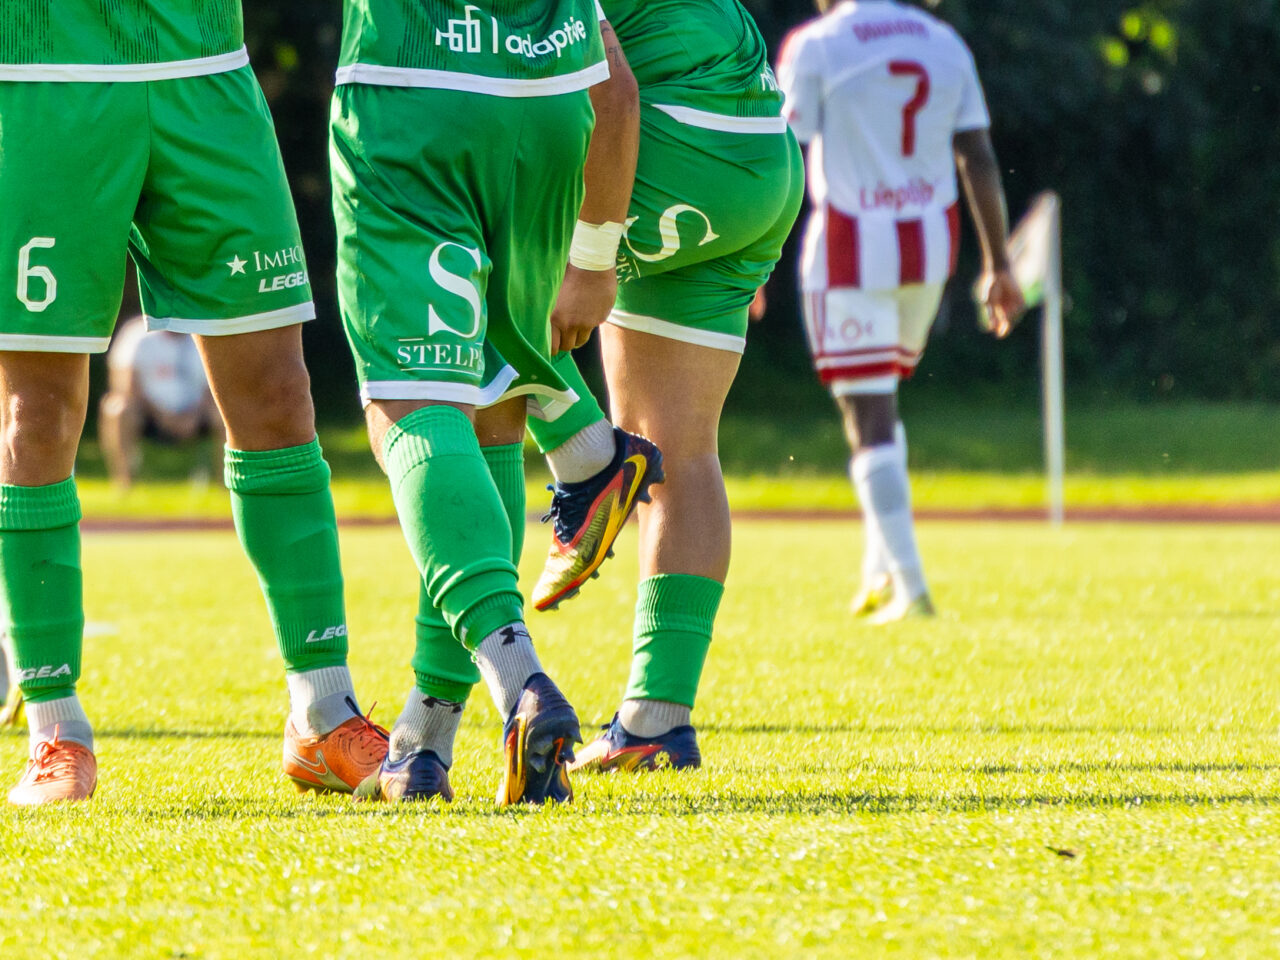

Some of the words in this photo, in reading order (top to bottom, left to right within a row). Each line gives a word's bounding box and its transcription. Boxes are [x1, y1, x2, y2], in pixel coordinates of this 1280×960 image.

[505, 16, 586, 58] adaptive
[887, 60, 931, 157] 7
[17, 237, 57, 312] 6
[428, 241, 481, 338] S
